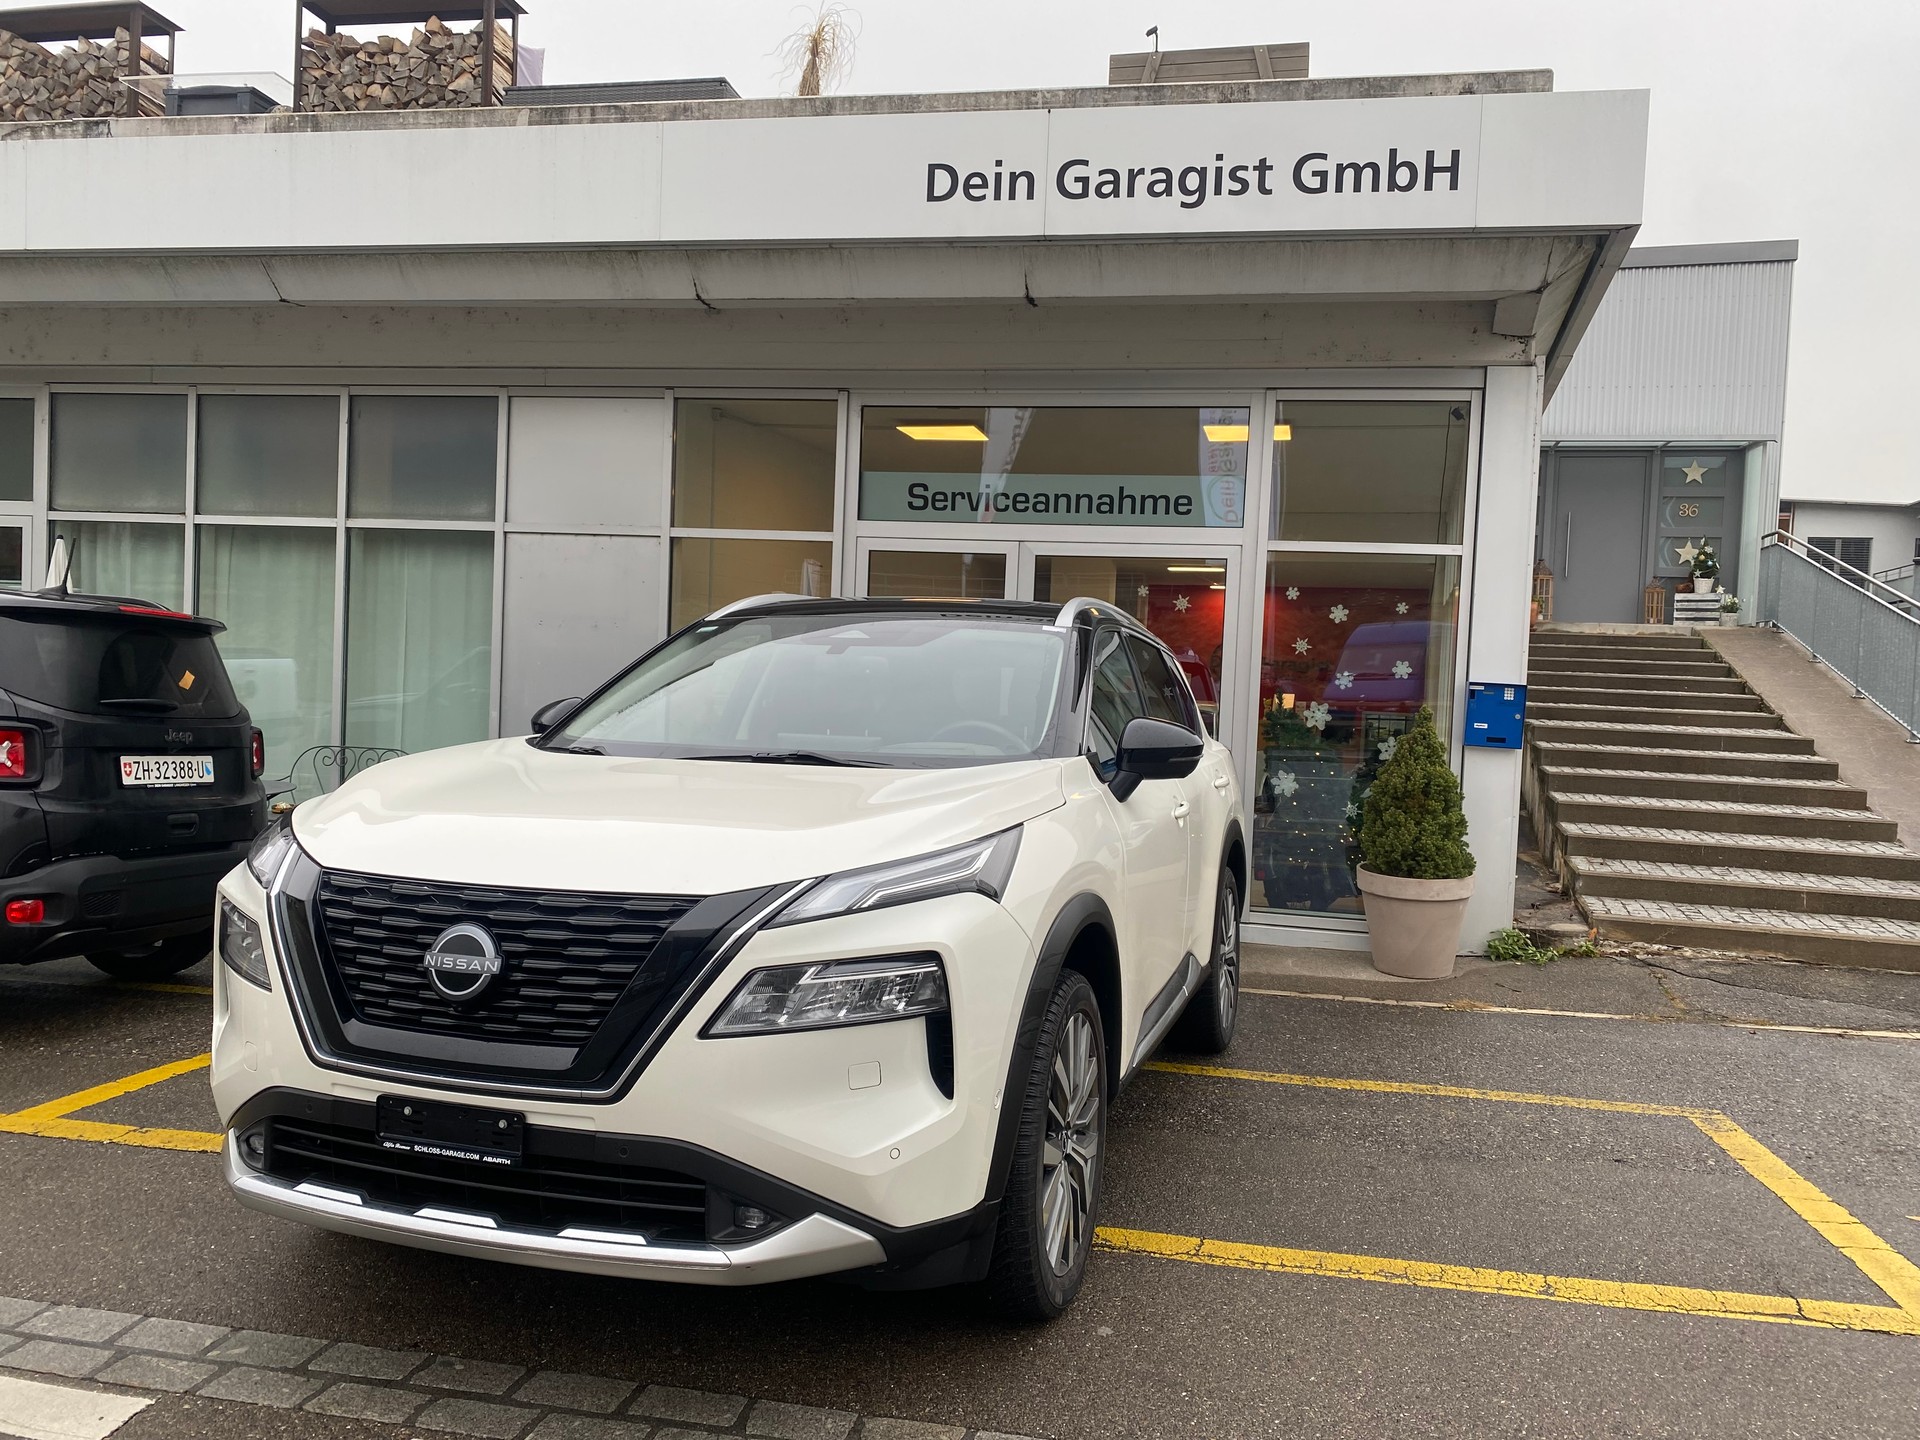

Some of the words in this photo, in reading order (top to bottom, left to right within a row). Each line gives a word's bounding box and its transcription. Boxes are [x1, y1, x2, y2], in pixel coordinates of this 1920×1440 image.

[926, 159, 1035, 202] Dein
[1056, 153, 1274, 209] Garagist
[1292, 148, 1461, 195] GmbH
[907, 482, 1193, 516] Serviceannahme
[1679, 503, 1699, 517] 36
[165, 729, 193, 744] Jeep
[425, 954, 498, 972] NISSAN
[414, 1145, 480, 1160] SCHLOSS-GARAGE.COM
[482, 1155, 511, 1165] ABARTH
